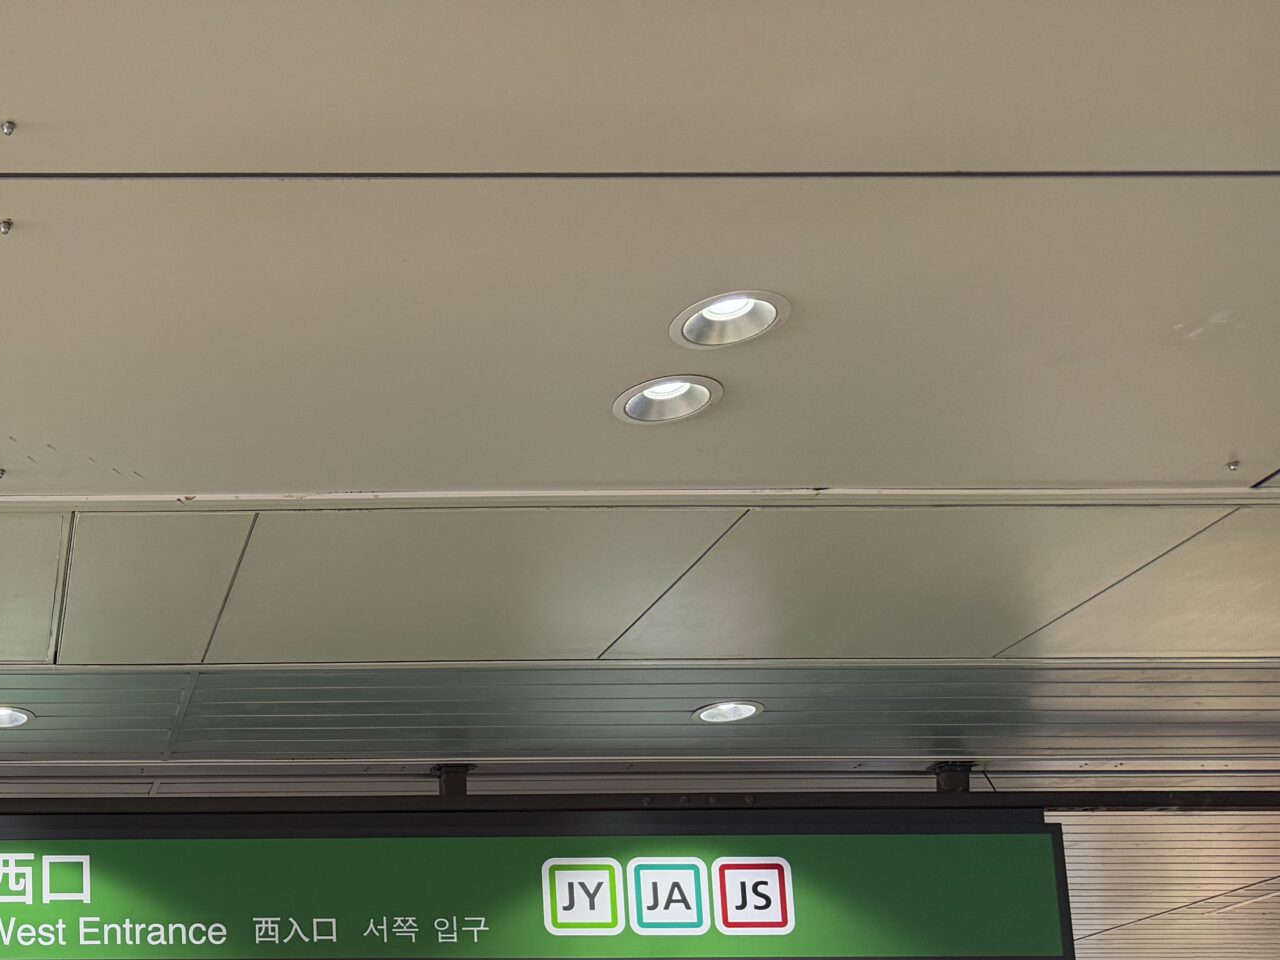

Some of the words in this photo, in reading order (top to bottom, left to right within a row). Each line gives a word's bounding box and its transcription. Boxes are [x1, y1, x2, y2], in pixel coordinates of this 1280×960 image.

[562, 881, 604, 912] JY
[646, 881, 692, 911] JA
[735, 880, 773, 911] JS
[79, 916, 228, 947] Entrance
[252, 918, 338, 944] 西入口
[362, 915, 420, 944] 서쪽
[434, 915, 490, 944] 입구
